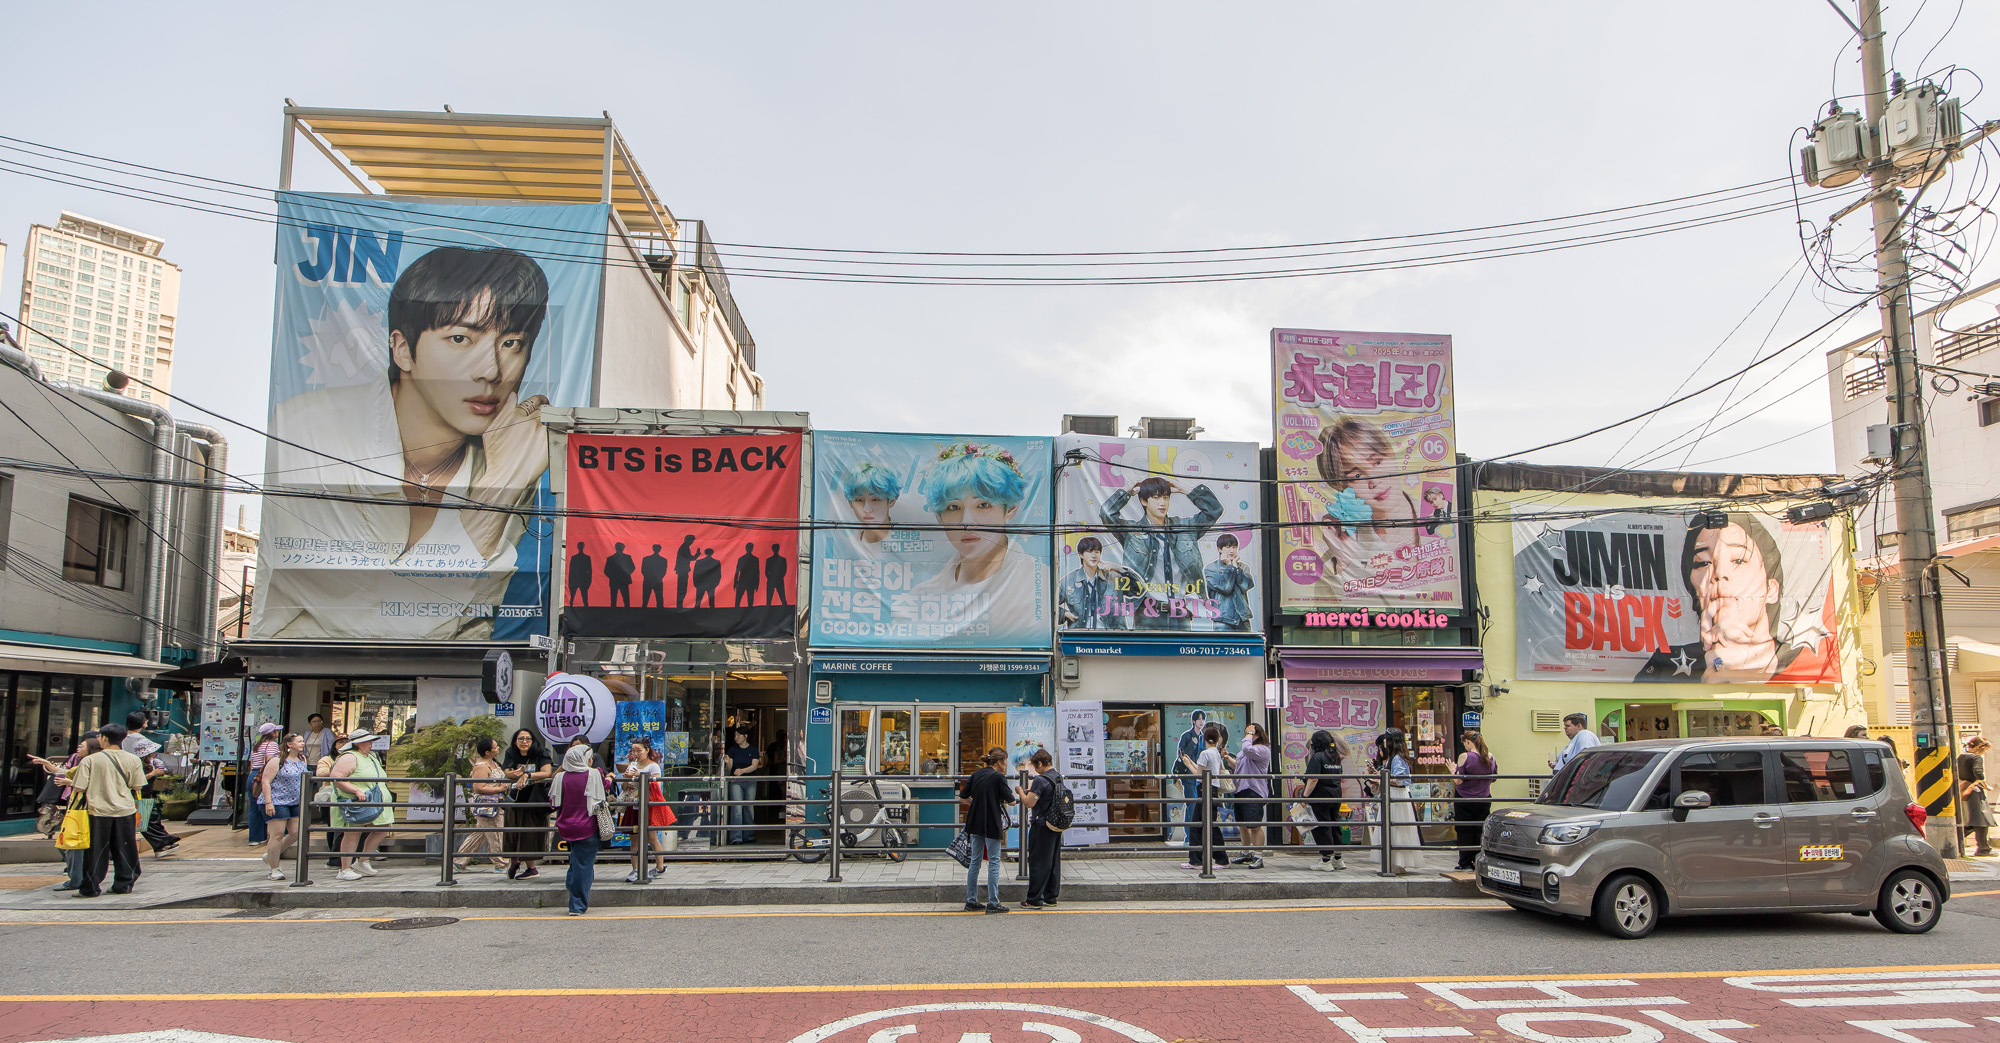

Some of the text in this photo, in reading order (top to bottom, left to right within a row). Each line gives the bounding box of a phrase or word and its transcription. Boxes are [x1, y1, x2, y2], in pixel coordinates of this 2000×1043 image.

[297, 222, 404, 284] JIN
[1285, 417, 1318, 427] VOL.1013
[1384, 416, 1441, 430] FOREVER AND EVER
[1424, 440, 1444, 455] 06
[578, 445, 788, 473] BTS is BACK
[366, 542, 390, 555] 있어
[903, 541, 934, 552] 보라해
[281, 552, 489, 569] ソクジンという光でいてくれてありがとう
[1292, 561, 1317, 572] 611
[1553, 530, 1669, 591] JIMIN
[822, 557, 914, 591] 태형아
[1034, 555, 1042, 622] WELCOME BACK
[1114, 576, 1204, 596] 12 years of
[1604, 584, 1626, 600] IS
[1431, 591, 1453, 601] JIMIN
[380, 602, 494, 618] KIM SEOK JIN
[498, 608, 543, 618] 20130613
[821, 589, 990, 623] 전역 축하해!
[1096, 595, 1222, 619] Jin & BTS
[1305, 607, 1448, 628] merci cookie
[1563, 591, 1672, 653] BACK
[821, 621, 871, 636] GOOD
[874, 622, 913, 637] BYE!
[962, 624, 990, 637] 추억
[1075, 646, 1250, 656] Bom market 050-7017-73461
[822, 662, 893, 671] MARINE COFFEE
[1317, 667, 1428, 679] merci cookie
[496, 703, 514, 711] 11-54
[540, 697, 586, 714] 아미가
[540, 715, 587, 728] 기다렸어
[621, 721, 660, 732] 정상 영업
[1418, 743, 1444, 754] merci
[1417, 755, 1446, 765] cookie
[1502, 870, 1517, 881] 1337
